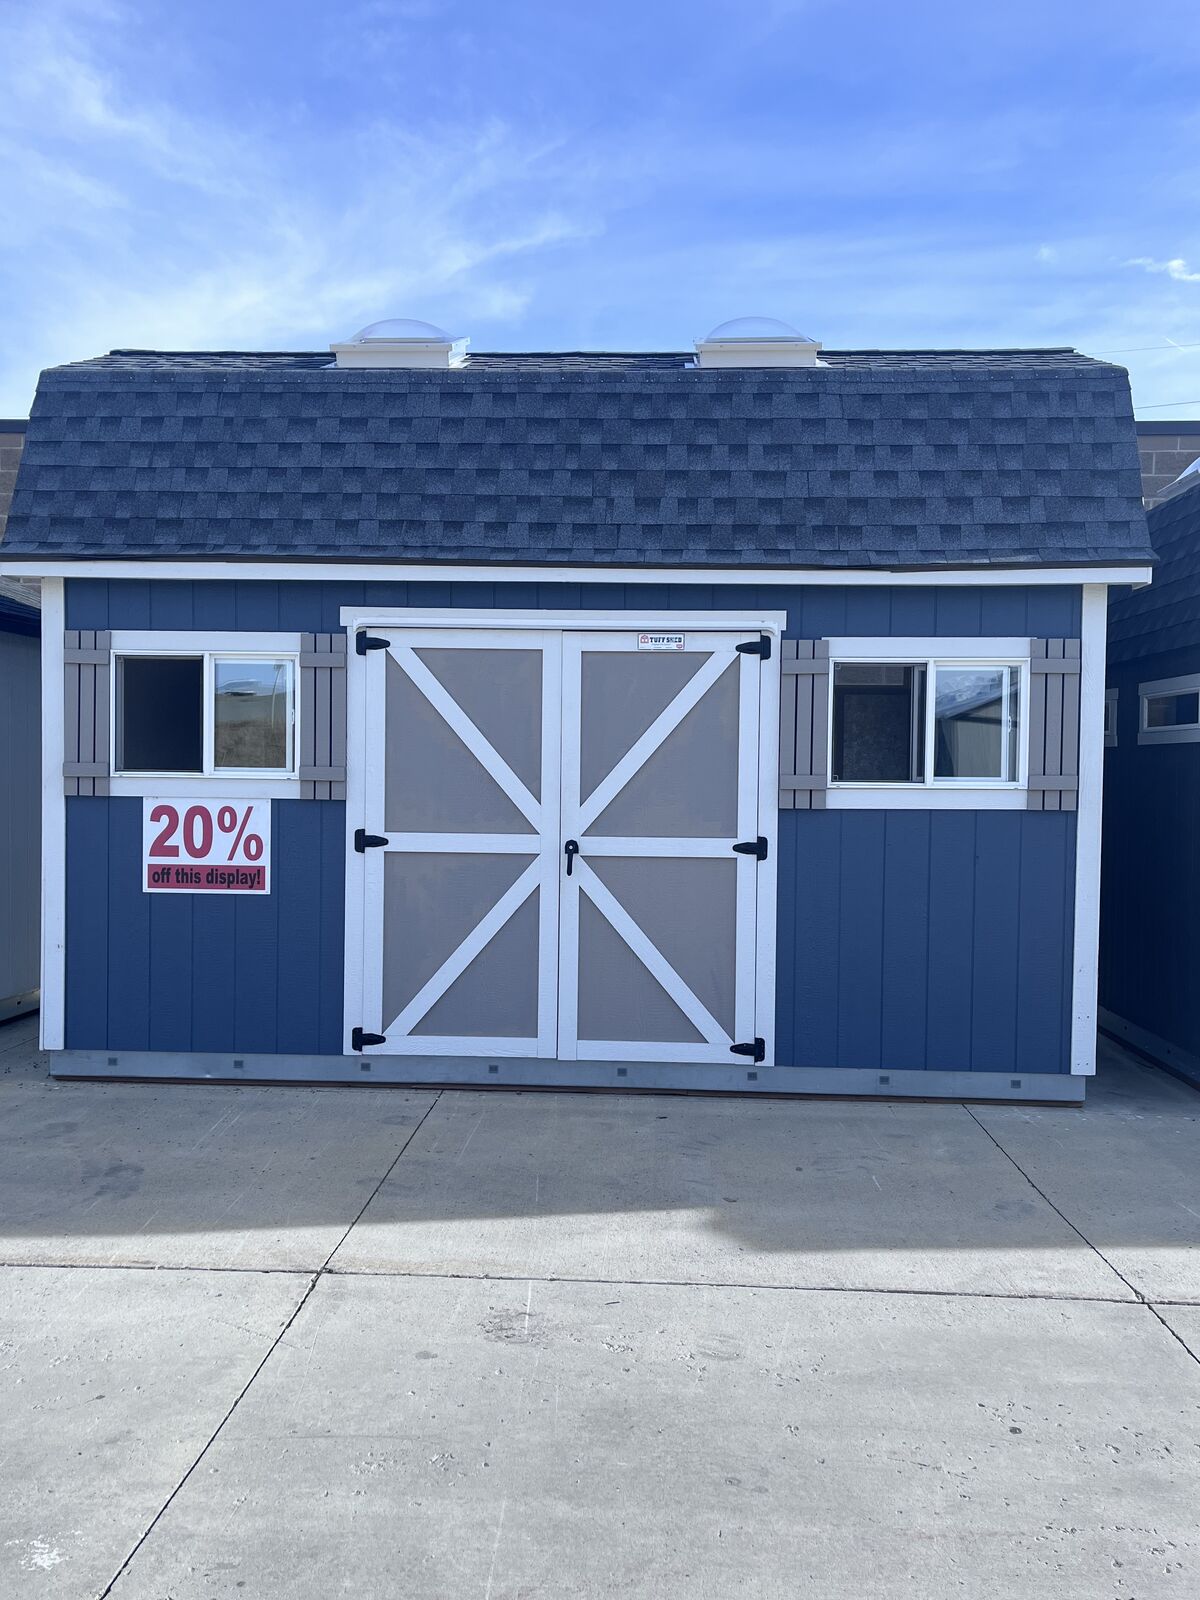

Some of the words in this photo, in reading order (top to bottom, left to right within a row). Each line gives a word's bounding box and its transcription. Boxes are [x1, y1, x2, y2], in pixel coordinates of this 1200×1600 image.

[149, 804, 264, 861] 20%
[152, 867, 171, 883] off
[175, 868, 201, 884] this
[206, 868, 261, 889] display!
